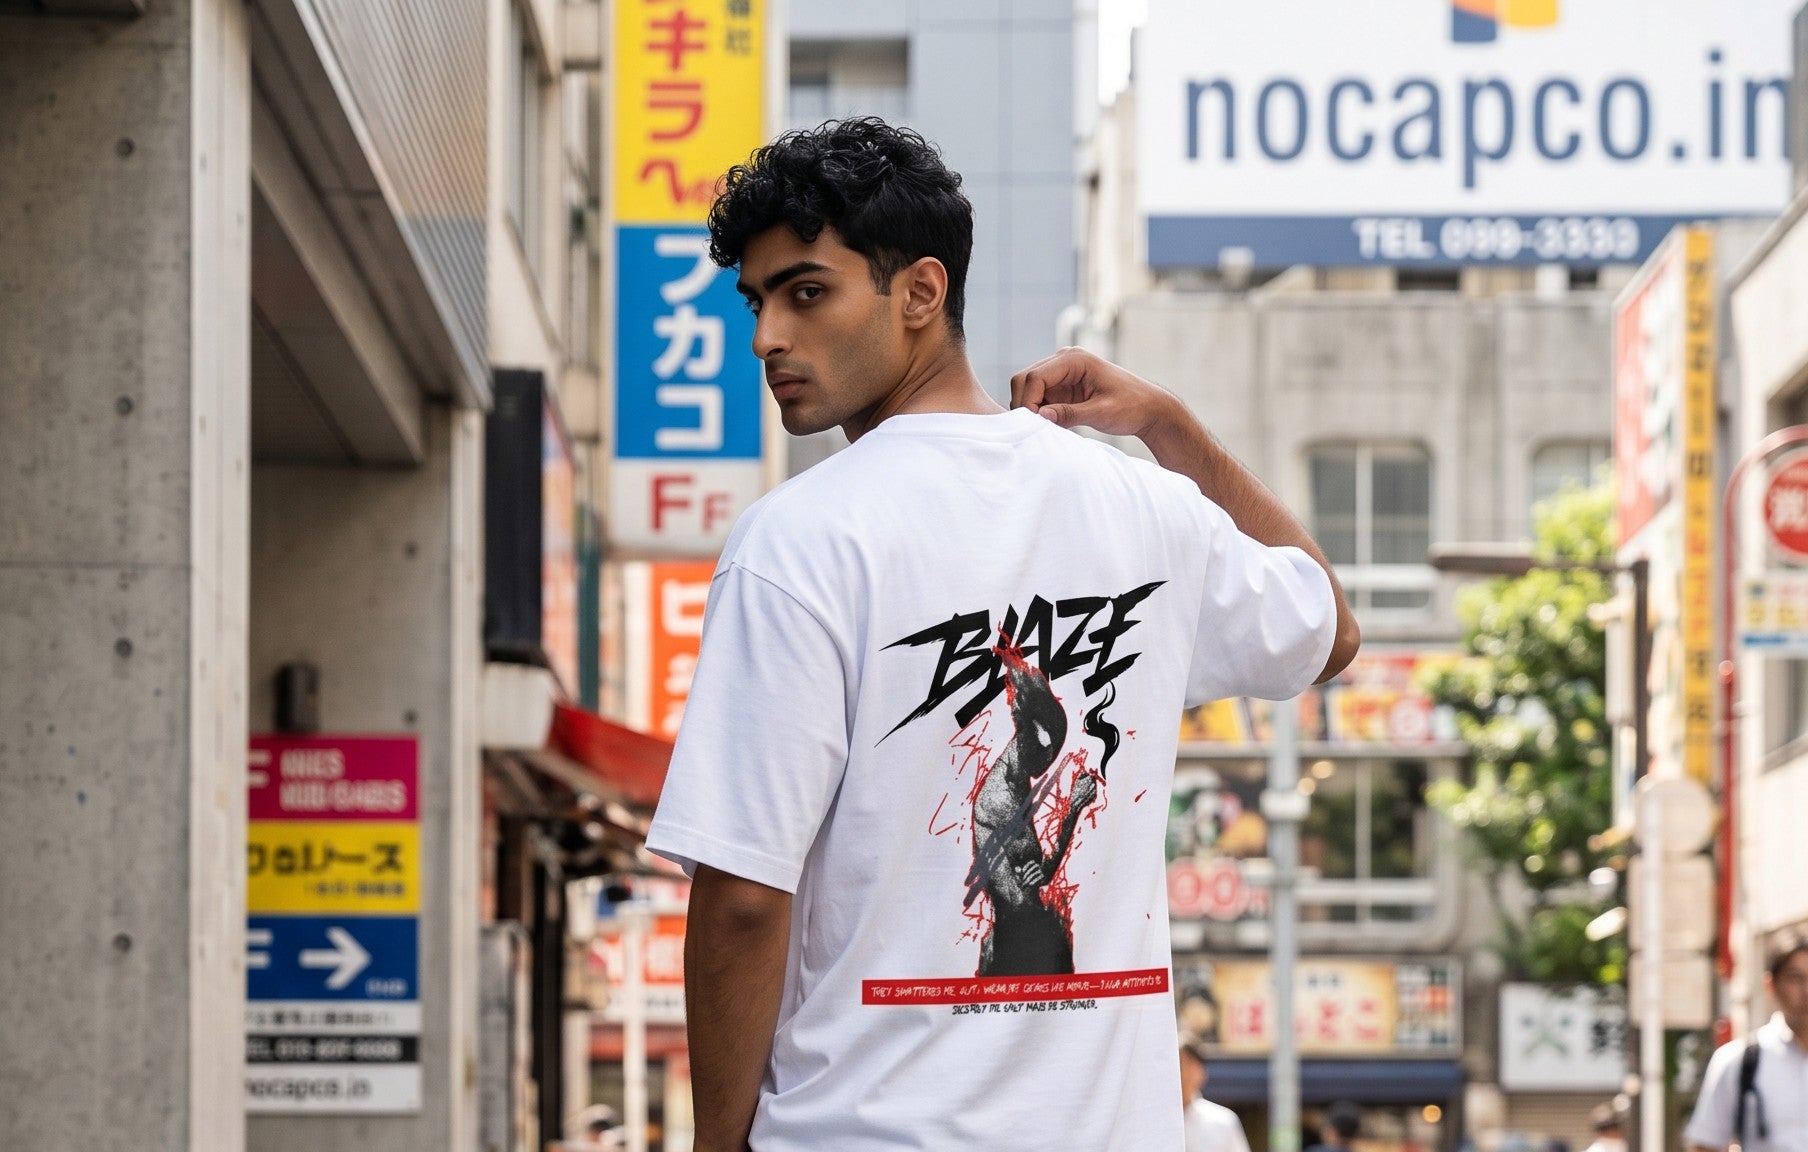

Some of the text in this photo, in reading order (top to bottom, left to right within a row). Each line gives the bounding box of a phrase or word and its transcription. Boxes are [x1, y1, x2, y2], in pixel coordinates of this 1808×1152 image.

[1184, 49, 1792, 191] nocapco.in
[1353, 218, 1434, 259] TEL
[874, 580, 1169, 748] BLAZE
